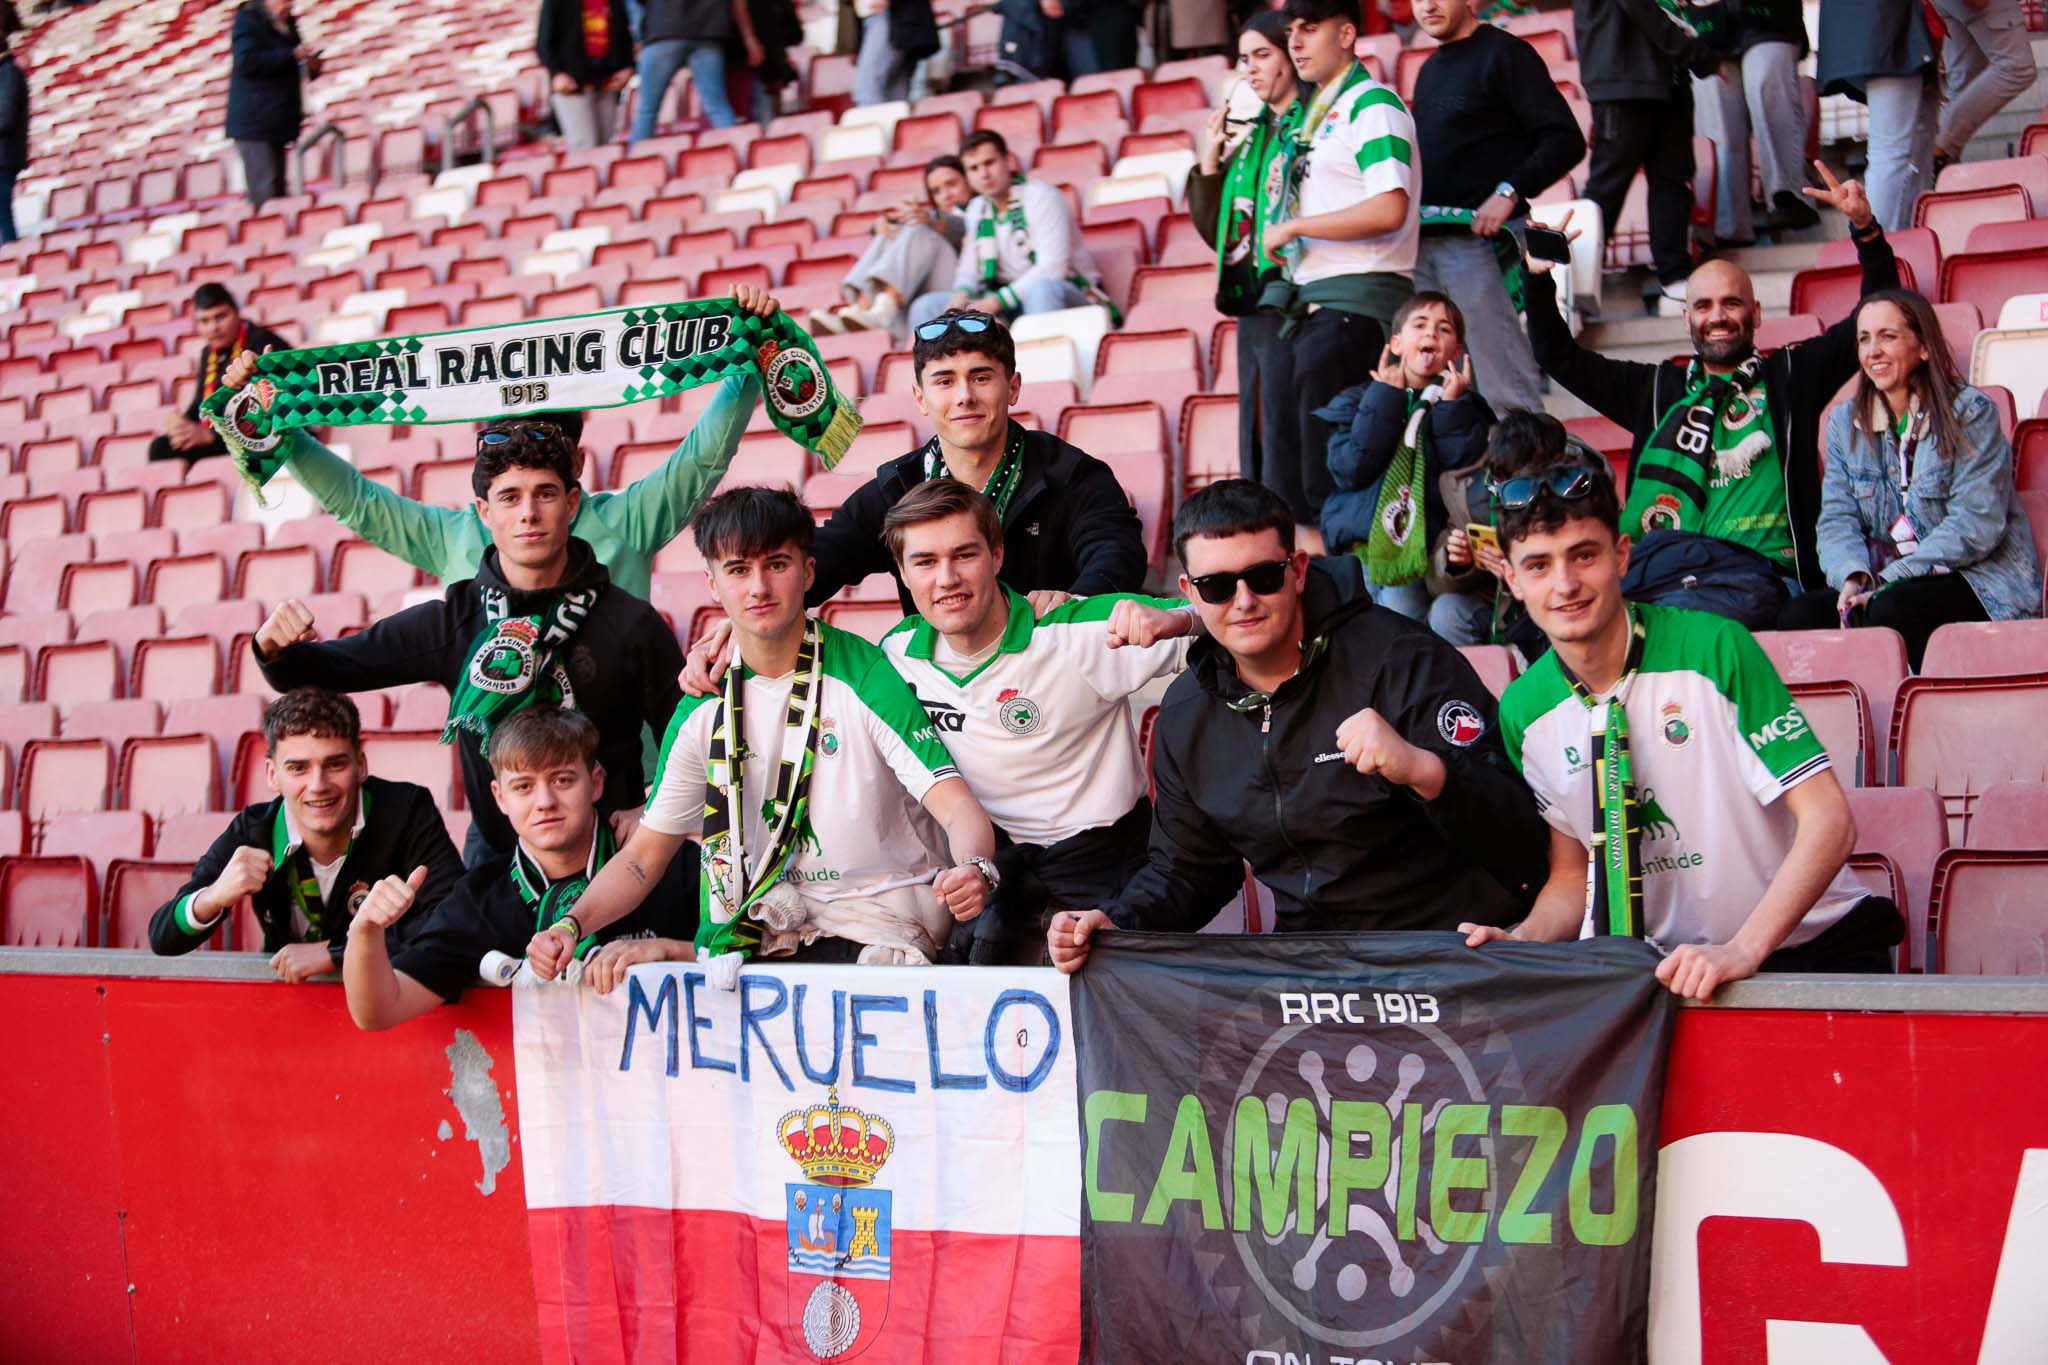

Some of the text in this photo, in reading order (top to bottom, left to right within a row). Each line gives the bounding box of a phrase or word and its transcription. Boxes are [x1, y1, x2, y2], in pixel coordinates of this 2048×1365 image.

[320, 315, 731, 397] REAL RACING CLUB
[500, 382, 548, 405] 1913
[1749, 708, 1803, 750] MGS
[619, 972, 1061, 1094] MERUELO
[1280, 993, 1440, 1024] RRC 1913
[1085, 1090, 1638, 1247] CAMPIEZO
